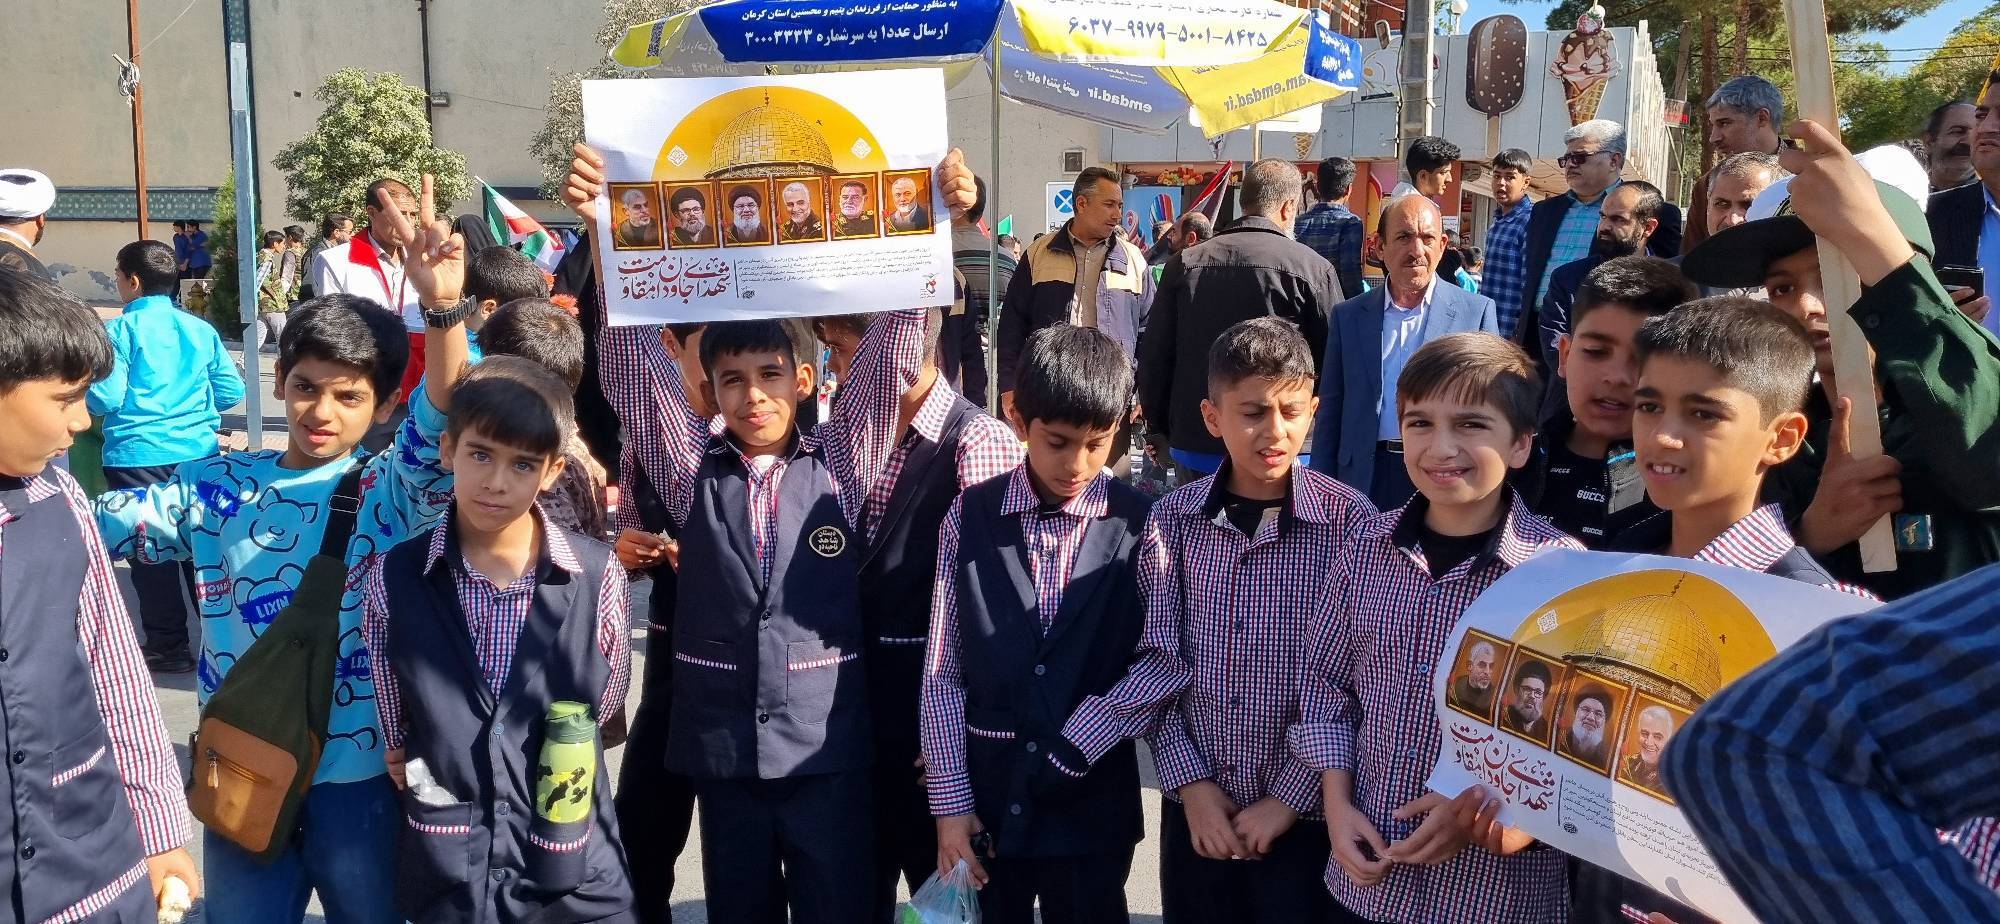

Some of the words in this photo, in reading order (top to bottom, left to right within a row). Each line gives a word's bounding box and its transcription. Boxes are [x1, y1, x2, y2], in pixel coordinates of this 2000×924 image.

[848, 5, 880, 16] فرزندان
[881, 3, 892, 13] از
[892, 2, 919, 11] حمایت
[921, 1, 947, 11] منظور
[742, 10, 766, 21] کرمان
[767, 9, 791, 19] استان
[867, 28, 878, 42] به
[912, 22, 949, 40] ارسال
[744, 28, 813, 46] ۳۰۰۰۳۳۳۳
